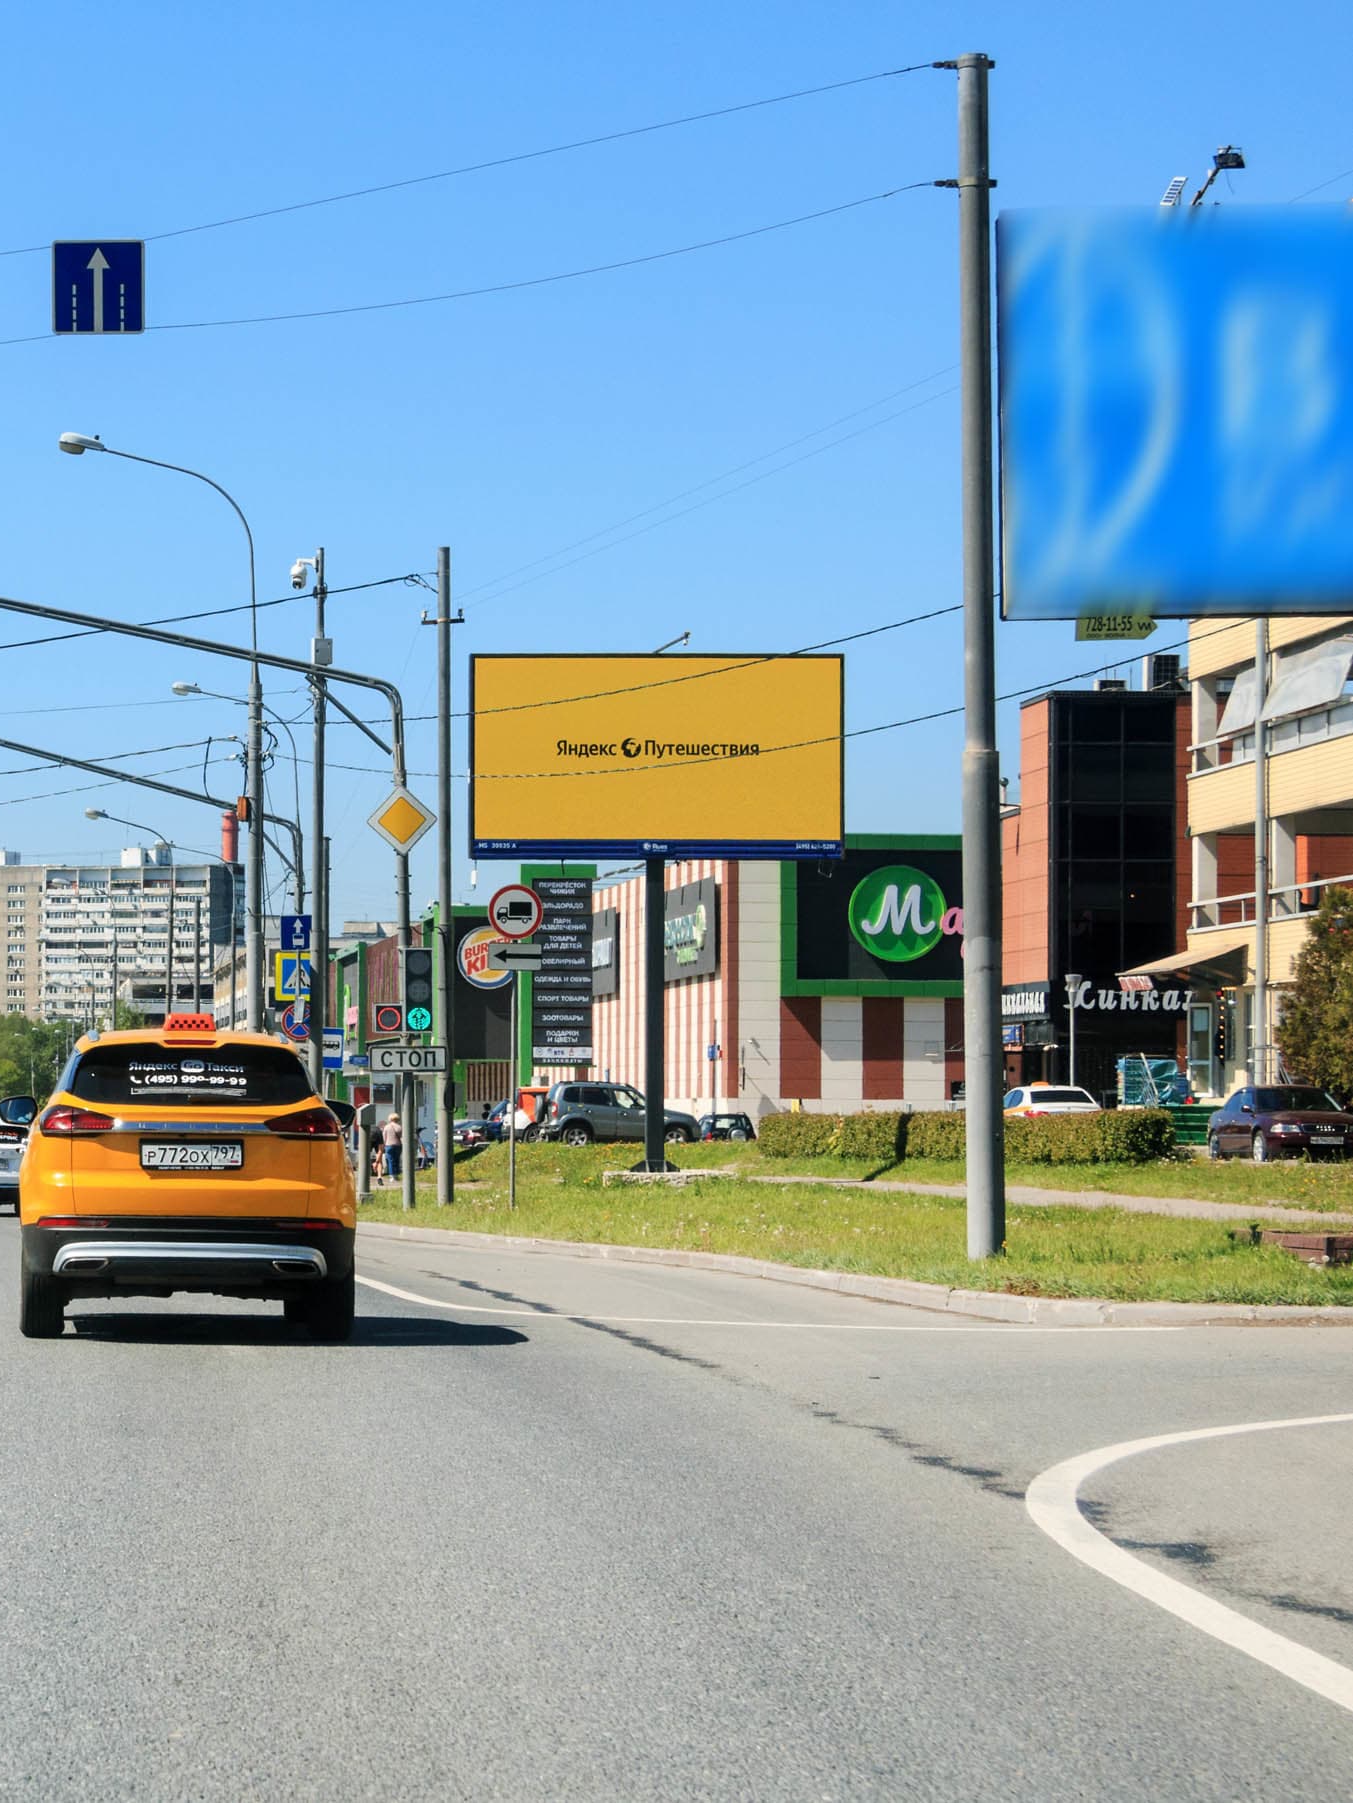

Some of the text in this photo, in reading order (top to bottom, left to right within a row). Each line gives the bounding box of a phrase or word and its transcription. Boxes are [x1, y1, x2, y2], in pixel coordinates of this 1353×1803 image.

[556, 740, 760, 759] Яндекс Путешествия
[466, 955, 487, 976] KI
[129, 1061, 178, 1071] Яндекс
[207, 1062, 244, 1072] Такси
[380, 1050, 437, 1068] СТОП
[144, 1075, 178, 1084] (495)
